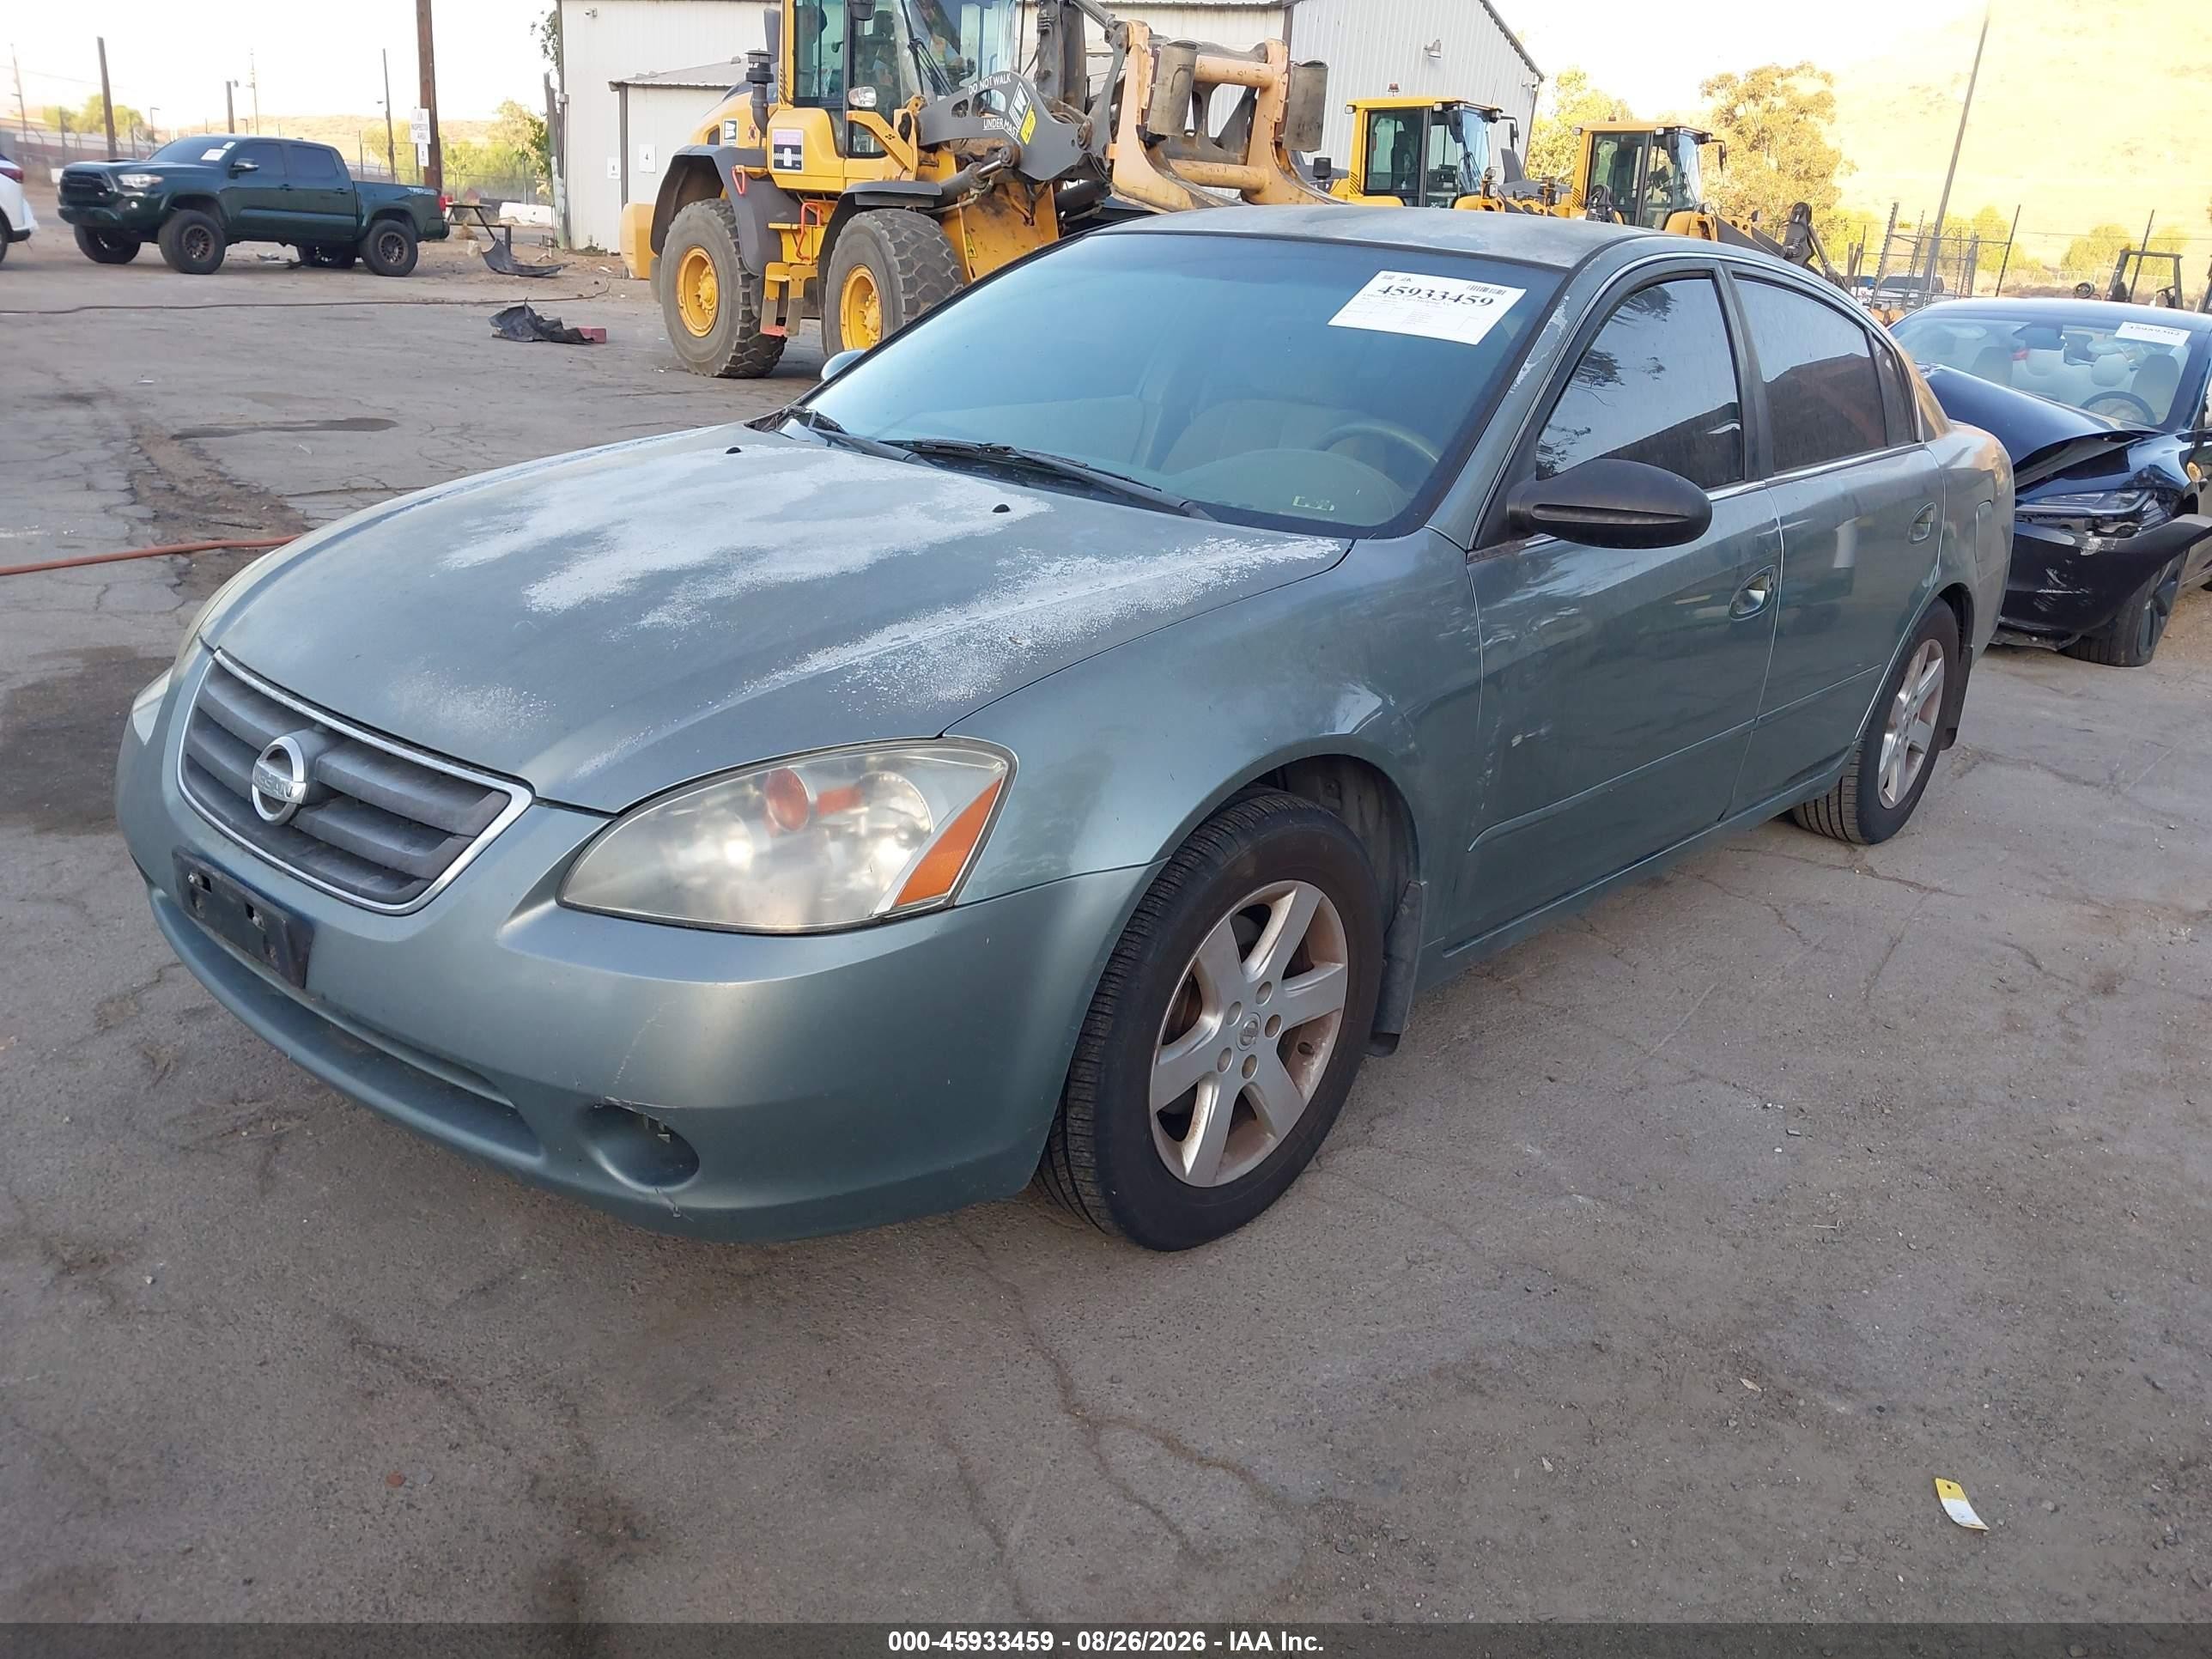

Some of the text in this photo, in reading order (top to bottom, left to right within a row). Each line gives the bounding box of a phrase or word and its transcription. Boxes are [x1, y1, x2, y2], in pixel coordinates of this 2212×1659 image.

[968, 73, 1012, 95] DO NOT WALK
[983, 117, 1020, 138] UNDER MAST
[1377, 284, 1494, 307] 45933459
